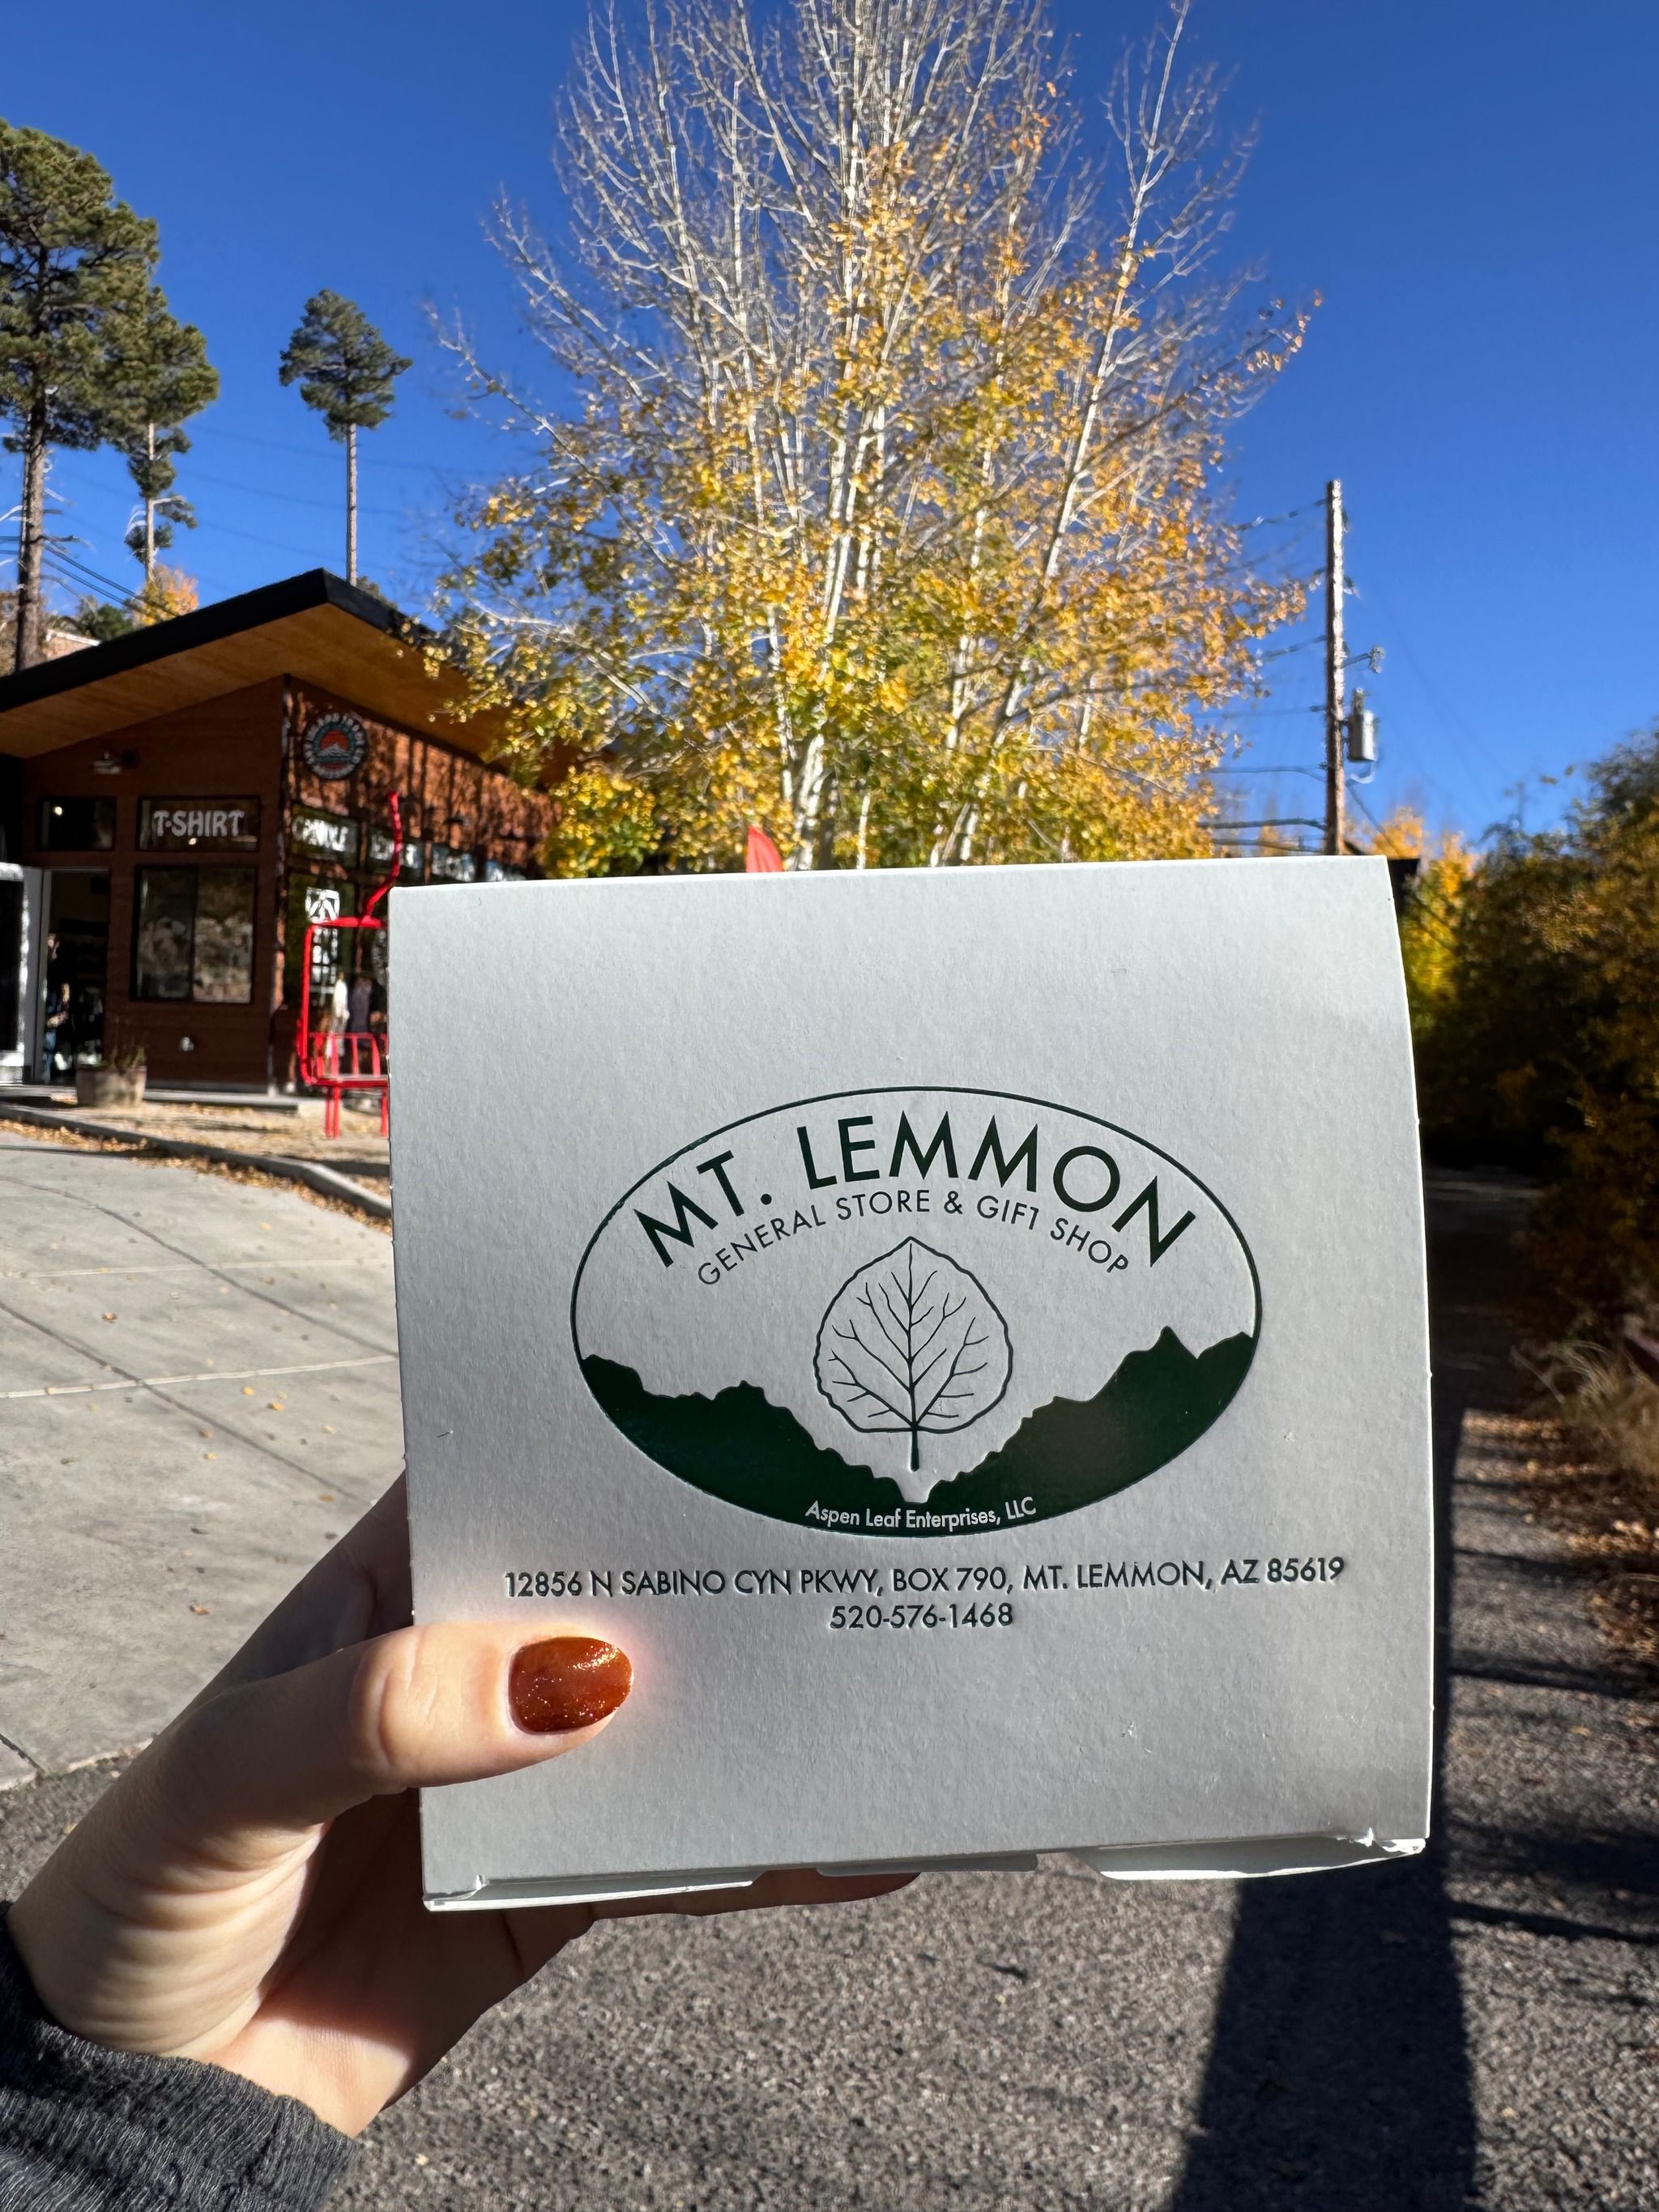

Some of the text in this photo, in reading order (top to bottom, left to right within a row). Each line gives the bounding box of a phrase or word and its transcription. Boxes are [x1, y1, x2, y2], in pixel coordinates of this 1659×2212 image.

[633, 1110, 1196, 1268] MT. LEMMON
[697, 1190, 1128, 1285] GENERAL STORE & GIFT SHOP
[804, 1496, 1037, 1532] Aspen Leaf Enterprises, LLC
[505, 1557, 1345, 1597] 12856 N SABINO CYN PKWY, BOX 790, MT. LEMMON, AZ 85619
[830, 1602, 1013, 1630] 520-576-1468
